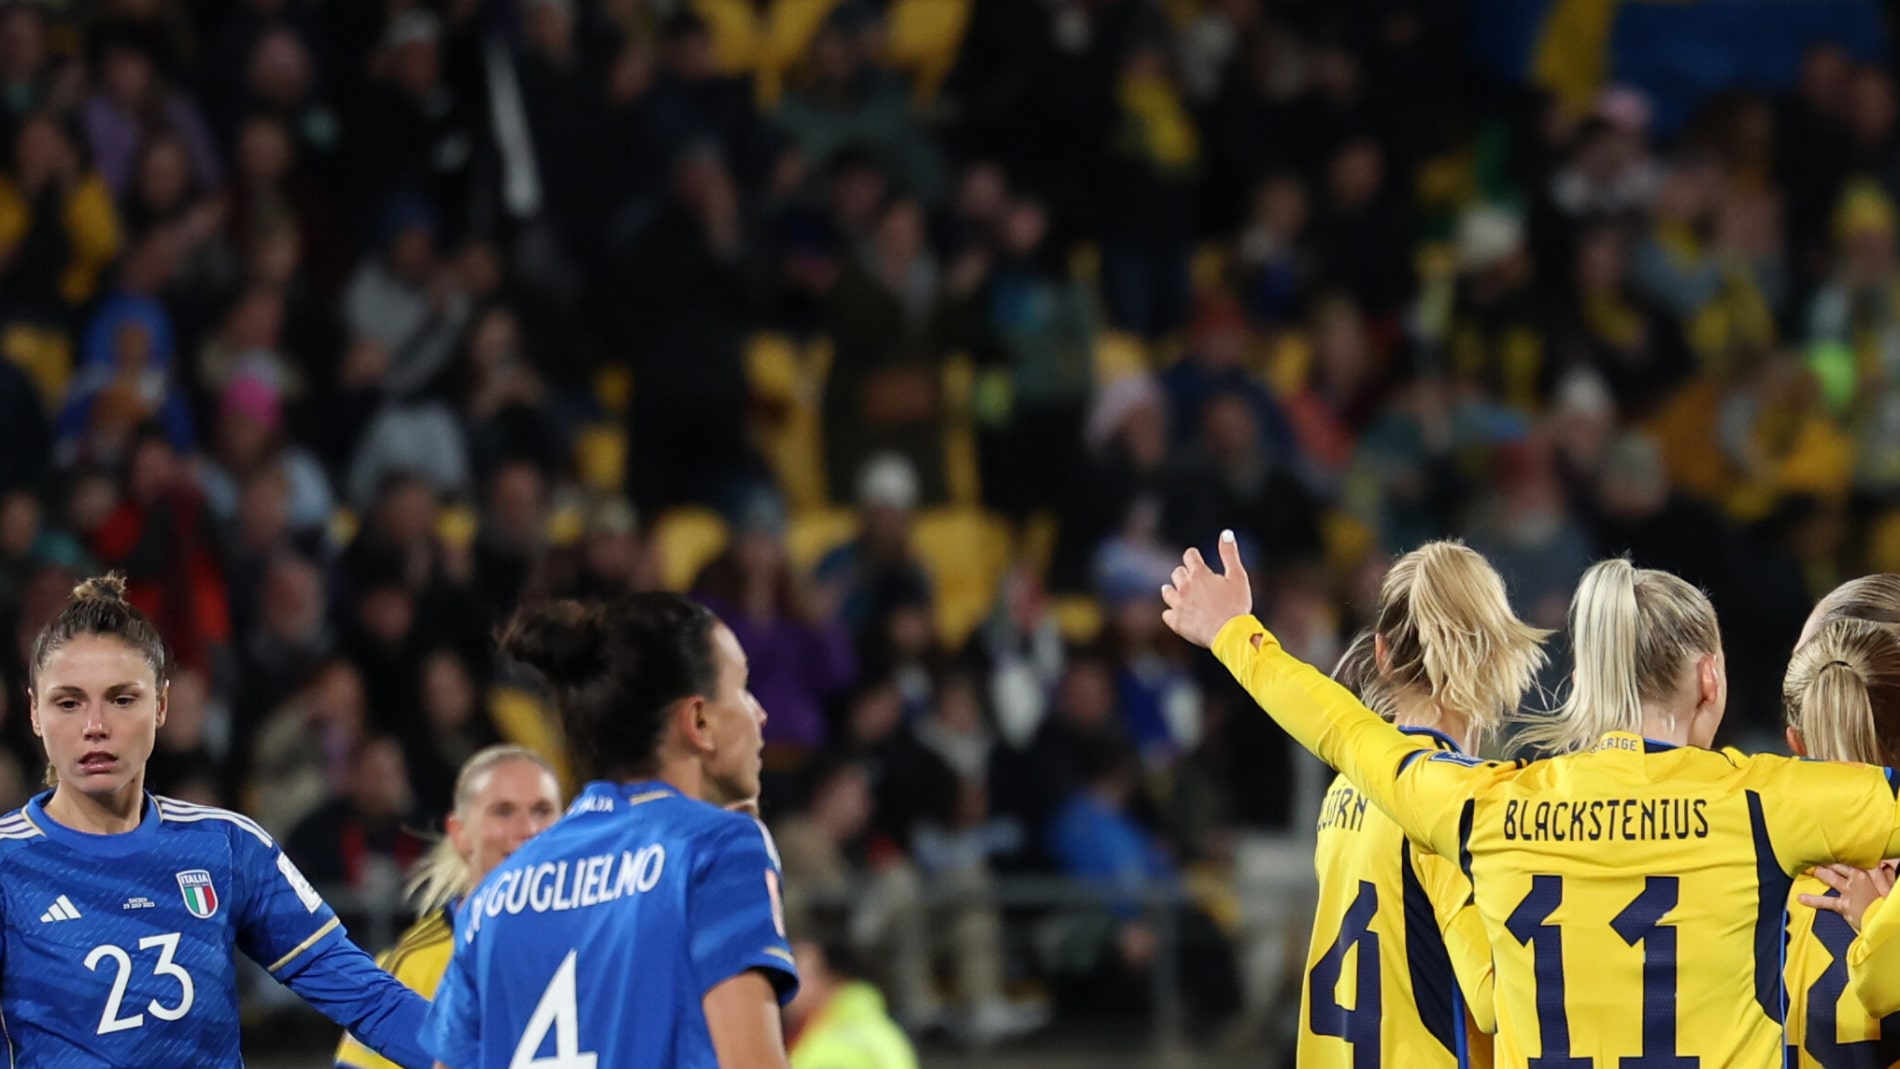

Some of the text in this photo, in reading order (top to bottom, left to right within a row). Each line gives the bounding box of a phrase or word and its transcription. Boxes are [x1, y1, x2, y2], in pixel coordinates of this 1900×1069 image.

[1504, 799, 1708, 841] BLACKSTENIUS
[180, 873, 209, 885] ITALIA
[486, 843, 666, 918] GUGLIELMO
[83, 932, 194, 1035] 23
